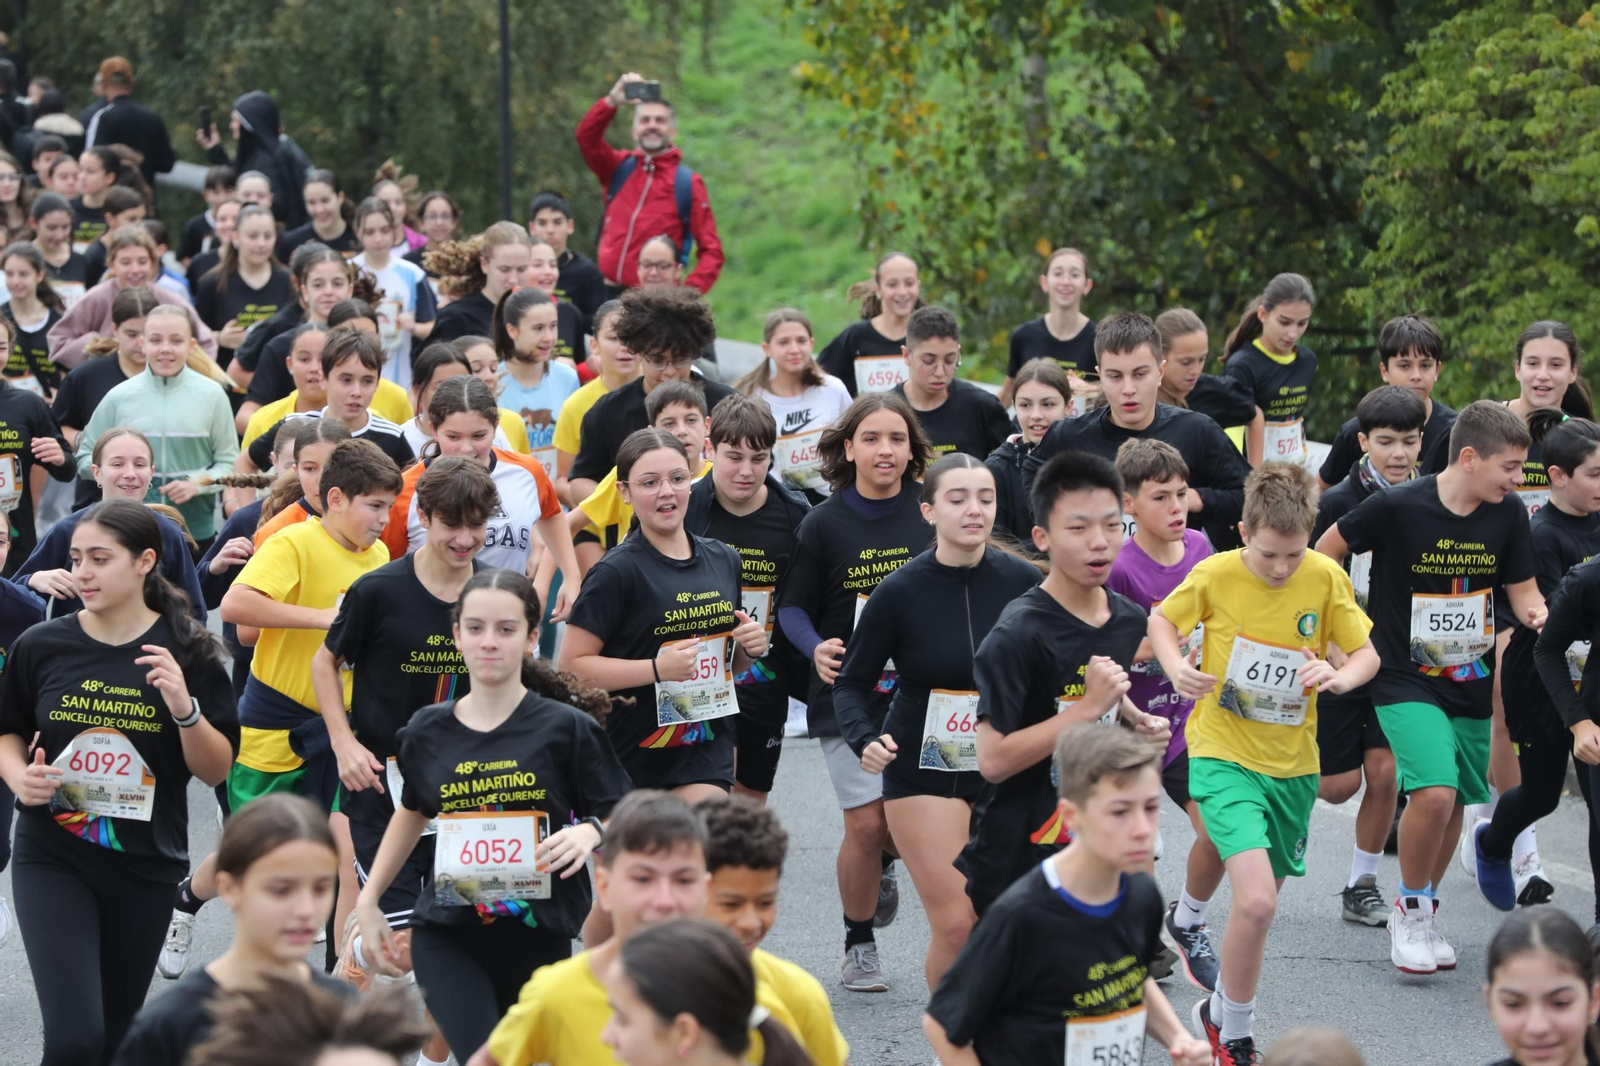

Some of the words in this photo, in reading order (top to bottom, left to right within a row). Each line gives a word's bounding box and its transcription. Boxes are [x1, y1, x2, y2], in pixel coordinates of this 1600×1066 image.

[867, 371, 903, 387] 6596
[786, 408, 812, 427] NIKE
[528, 428, 554, 448] FOR
[1436, 539, 1455, 550] 48º
[1454, 542, 1485, 550] CARREIRA
[859, 548, 877, 560] 48º
[877, 547, 909, 557] CARREIRA
[1421, 553, 1445, 564] SAN
[1446, 554, 1496, 566] MARTIÑO
[847, 565, 870, 578] SAN
[1411, 564, 1455, 575] CONCELLO
[1456, 567, 1466, 575] DE
[843, 576, 882, 589] CONCELLO
[676, 592, 692, 603] 48º
[692, 591, 720, 601] CARREIRA
[664, 609, 687, 623] SAN
[689, 600, 734, 618] MARTIÑO
[654, 620, 697, 635] CONCELLO
[698, 620, 708, 629] DE
[1429, 612, 1477, 632] 5524
[426, 634, 445, 646] 48º
[410, 651, 435, 662] SAN
[1269, 651, 1290, 660] ADRIÁN
[400, 663, 443, 674] CONCELLO
[444, 665, 457, 673] DE
[1246, 661, 1298, 688] 6191
[81, 679, 104, 692] 48º
[103, 686, 141, 697] CARREIRA
[1064, 684, 1086, 697] SAN
[61, 695, 90, 709] SAN
[92, 698, 156, 718] MARTIÑO
[49, 711, 101, 725] CONCELLO
[103, 717, 116, 727] DE
[116, 719, 162, 732] OURENSE
[92, 736, 111, 746] SOFÍA
[69, 750, 131, 776] 6092
[455, 761, 478, 775] 48º
[478, 760, 518, 772] CARREIRA
[440, 782, 470, 798] SAN
[472, 771, 536, 794] MARTIÑO
[485, 794, 498, 804] DE
[499, 789, 547, 802] OURENSE
[481, 822, 497, 831] UXÍA
[459, 838, 523, 865] 6052
[1073, 987, 1106, 1009] SAN
